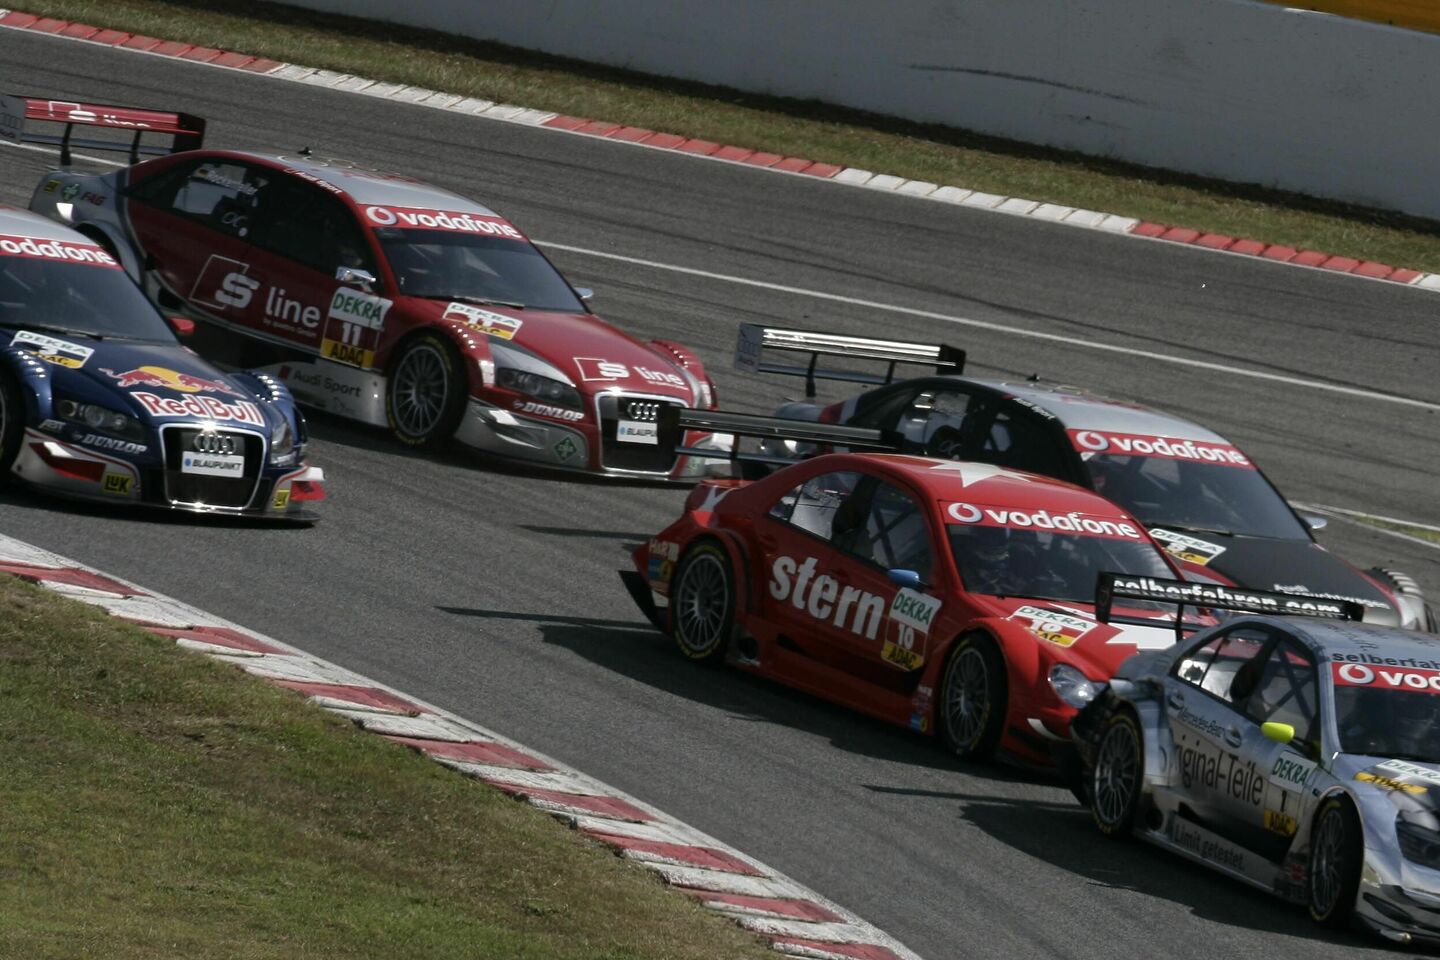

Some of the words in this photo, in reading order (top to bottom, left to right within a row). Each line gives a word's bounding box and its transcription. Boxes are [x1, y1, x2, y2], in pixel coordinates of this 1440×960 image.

[399, 209, 522, 239] vodafone
[0, 238, 118, 265] odafone
[215, 271, 261, 310] S
[263, 286, 322, 330] line
[332, 292, 384, 323] DEKRA
[451, 303, 518, 328] DEKRA
[19, 331, 89, 355] DEKRA
[341, 322, 363, 348] 11
[329, 343, 364, 368] ADAC
[292, 368, 323, 388] Audi
[324, 374, 362, 399] Sport
[597, 362, 630, 379] S
[633, 365, 686, 388] line
[131, 391, 202, 418] Red
[200, 397, 266, 427] Bull
[522, 401, 585, 423] DUNLOP
[38, 418, 67, 431] ABT
[81, 433, 148, 456] DUNLOP
[1111, 435, 1250, 467] vodafone
[191, 458, 243, 474] BLAUPUNKT
[985, 509, 1140, 539] vodafone
[1151, 528, 1221, 552] DEKRA
[769, 554, 886, 641] stern
[893, 591, 934, 626] DEKRA
[1019, 605, 1090, 630] DEKRA
[1031, 618, 1064, 634] 10
[896, 621, 915, 652] 10
[888, 645, 918, 669] ADAC
[1175, 706, 1225, 739] Mercedes-Benz
[1271, 757, 1310, 786] DEKRA
[1174, 822, 1202, 849] Limit
[1269, 813, 1293, 835] ADAC
